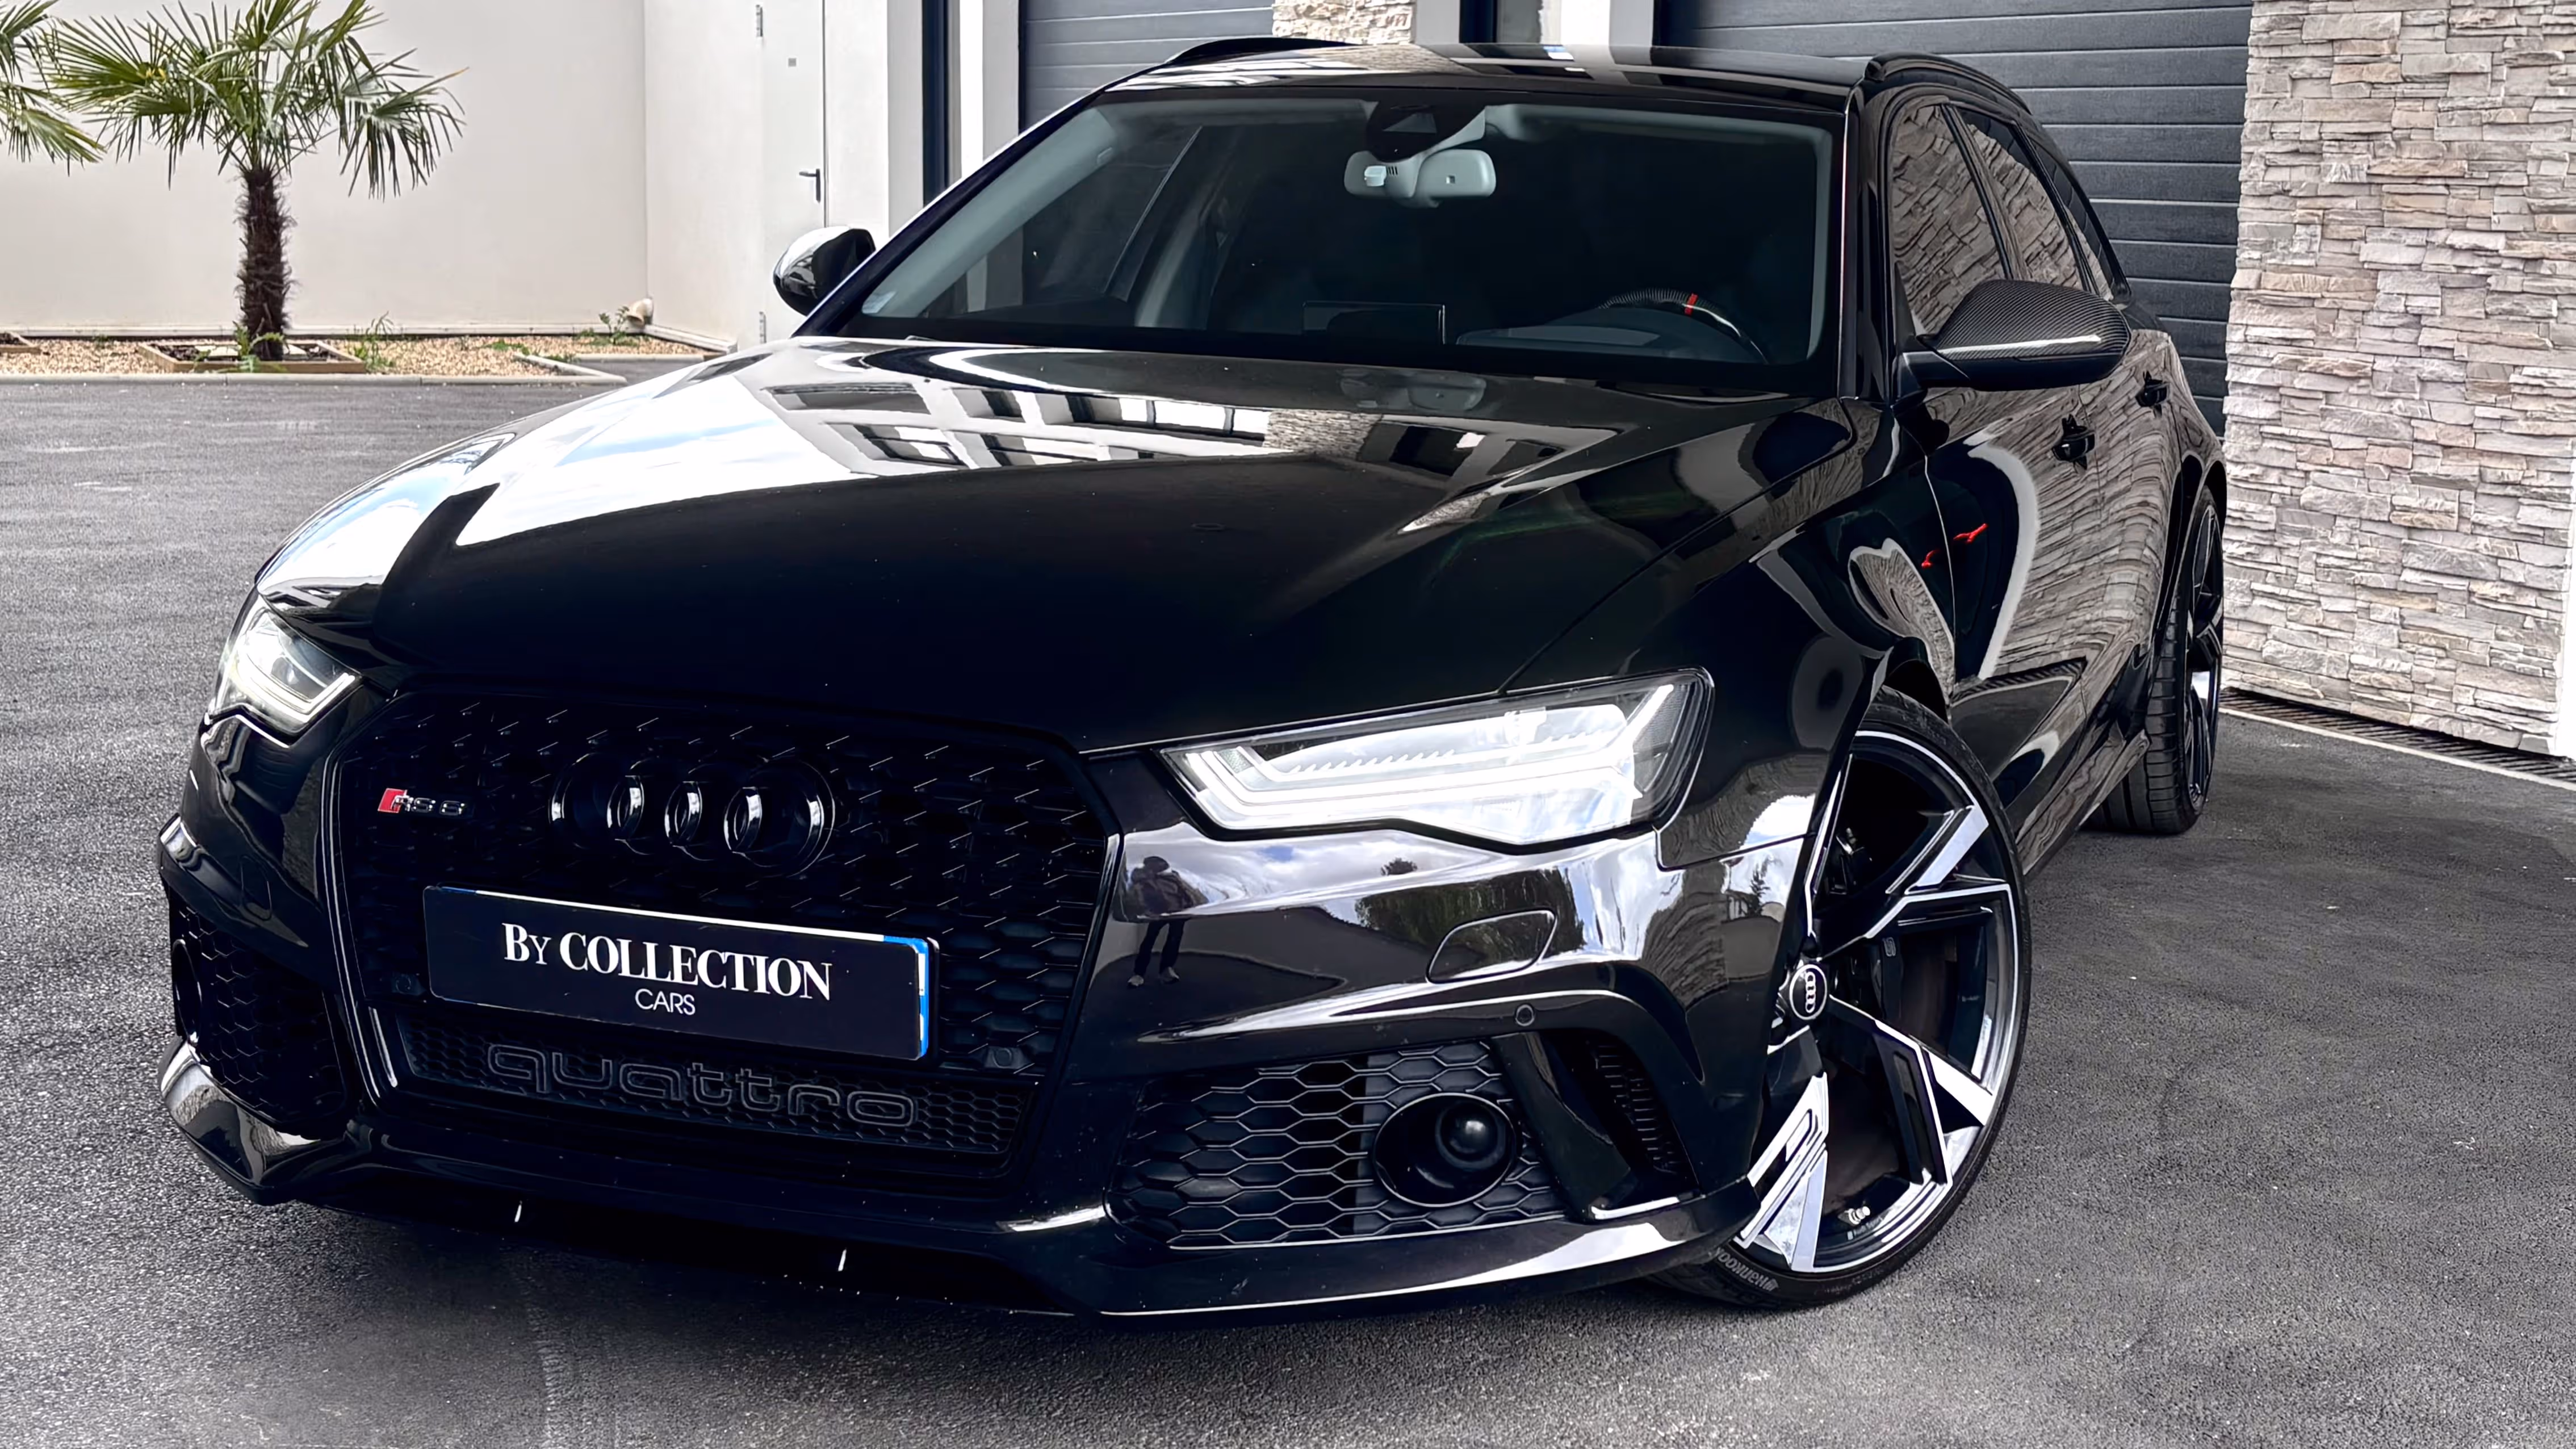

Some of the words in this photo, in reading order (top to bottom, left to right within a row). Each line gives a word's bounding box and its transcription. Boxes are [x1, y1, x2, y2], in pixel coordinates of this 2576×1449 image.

[559, 932, 833, 1000] COLLECTION
[635, 989, 696, 1015] CARS
[487, 1043, 919, 1127] quattro
